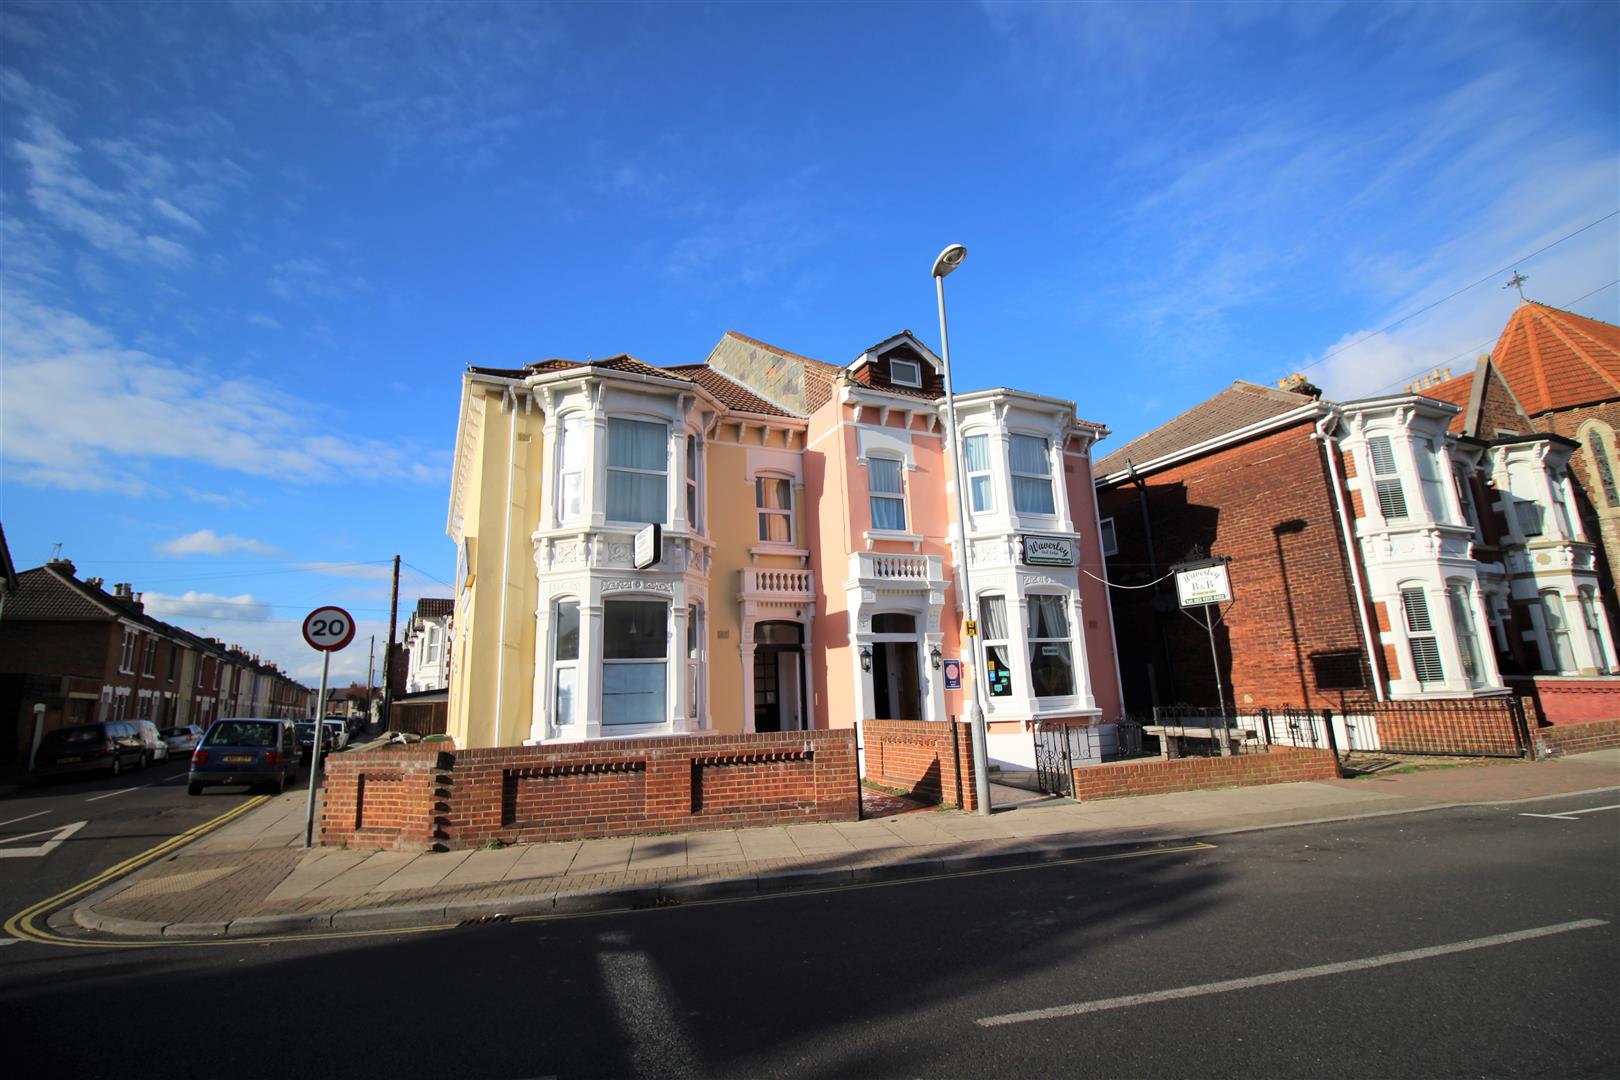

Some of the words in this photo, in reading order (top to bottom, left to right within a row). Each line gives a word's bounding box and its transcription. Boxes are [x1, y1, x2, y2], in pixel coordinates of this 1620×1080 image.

[1029, 541, 1069, 557] Waverley
[1183, 569, 1221, 583] Waverley
[312, 620, 345, 636] 20
[966, 621, 977, 634] H
